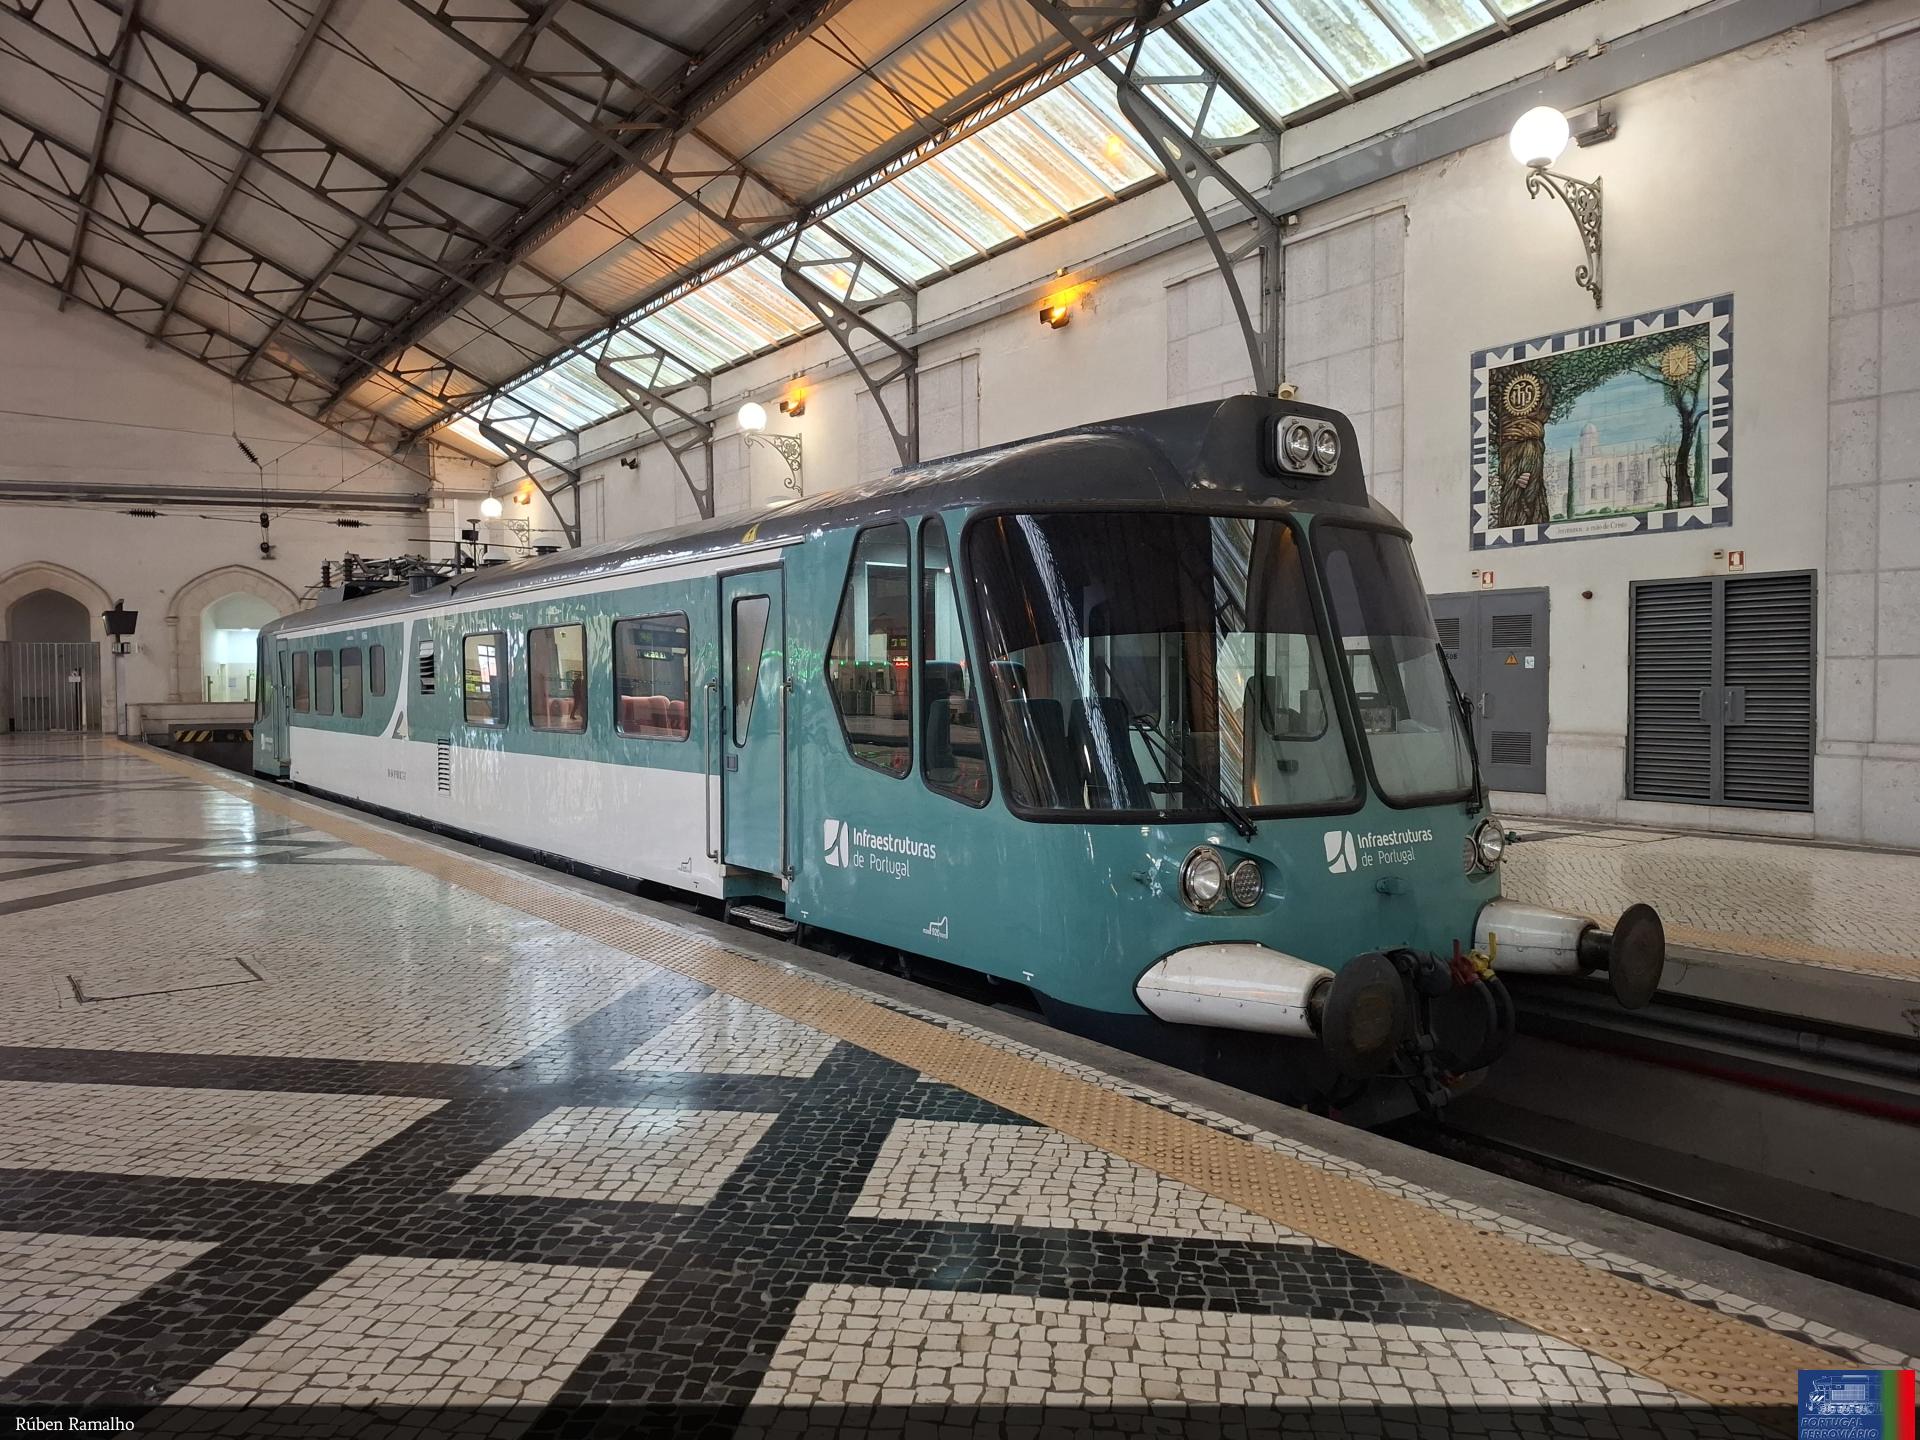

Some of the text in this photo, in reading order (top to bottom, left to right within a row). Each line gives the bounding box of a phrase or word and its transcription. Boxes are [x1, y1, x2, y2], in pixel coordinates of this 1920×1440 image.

[853, 828, 937, 860] Infraestruturas
[1357, 828, 1433, 849] Infraestruturas
[853, 850, 910, 880] de Portugal
[1361, 847, 1416, 867] de Portugal
